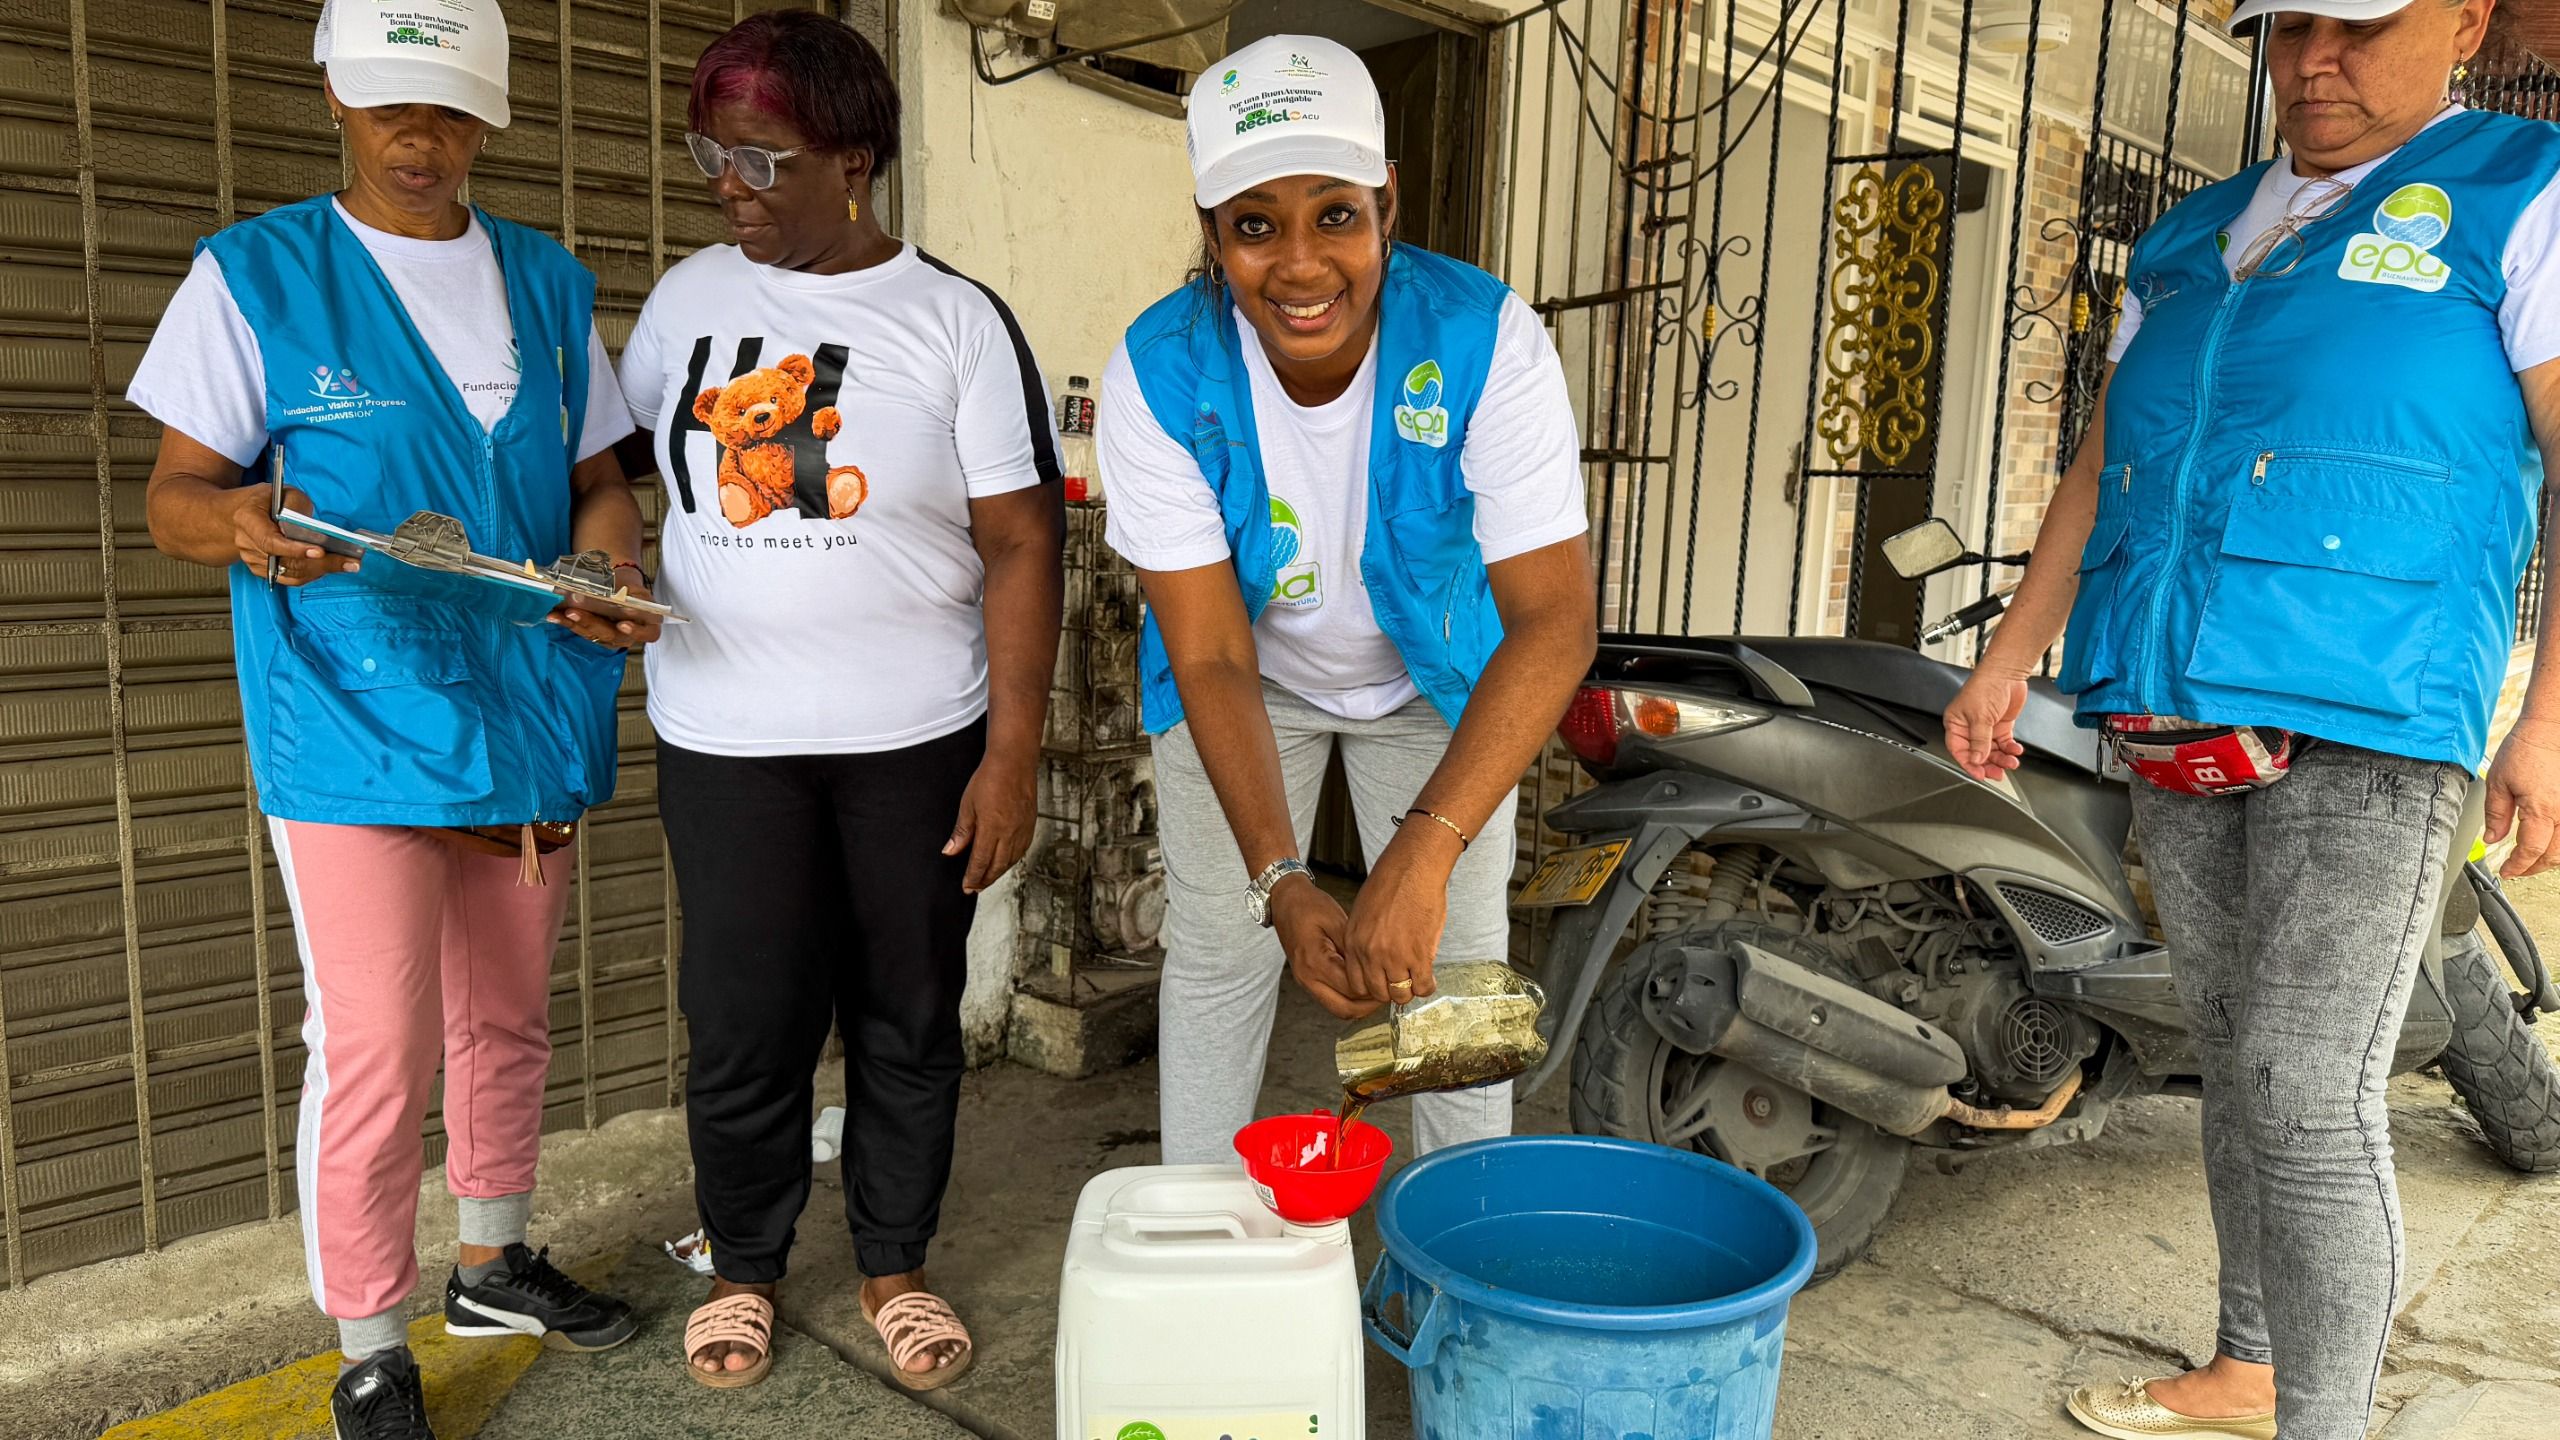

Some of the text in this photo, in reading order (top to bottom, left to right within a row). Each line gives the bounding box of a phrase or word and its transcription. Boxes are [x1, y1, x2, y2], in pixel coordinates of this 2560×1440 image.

[380, 11, 394, 19] Por
[389, 18, 416, 27] Bonita
[1229, 101, 1243, 112] Por
[1244, 95, 1260, 105] una
[1238, 101, 1264, 115] Bonita
[1265, 100, 1271, 108] y
[2350, 242, 2445, 280] epa
[357, 400, 363, 408] y
[365, 399, 407, 408] Progreso
[1399, 411, 1444, 441] epa
[700, 531, 858, 551] nice to meet you
